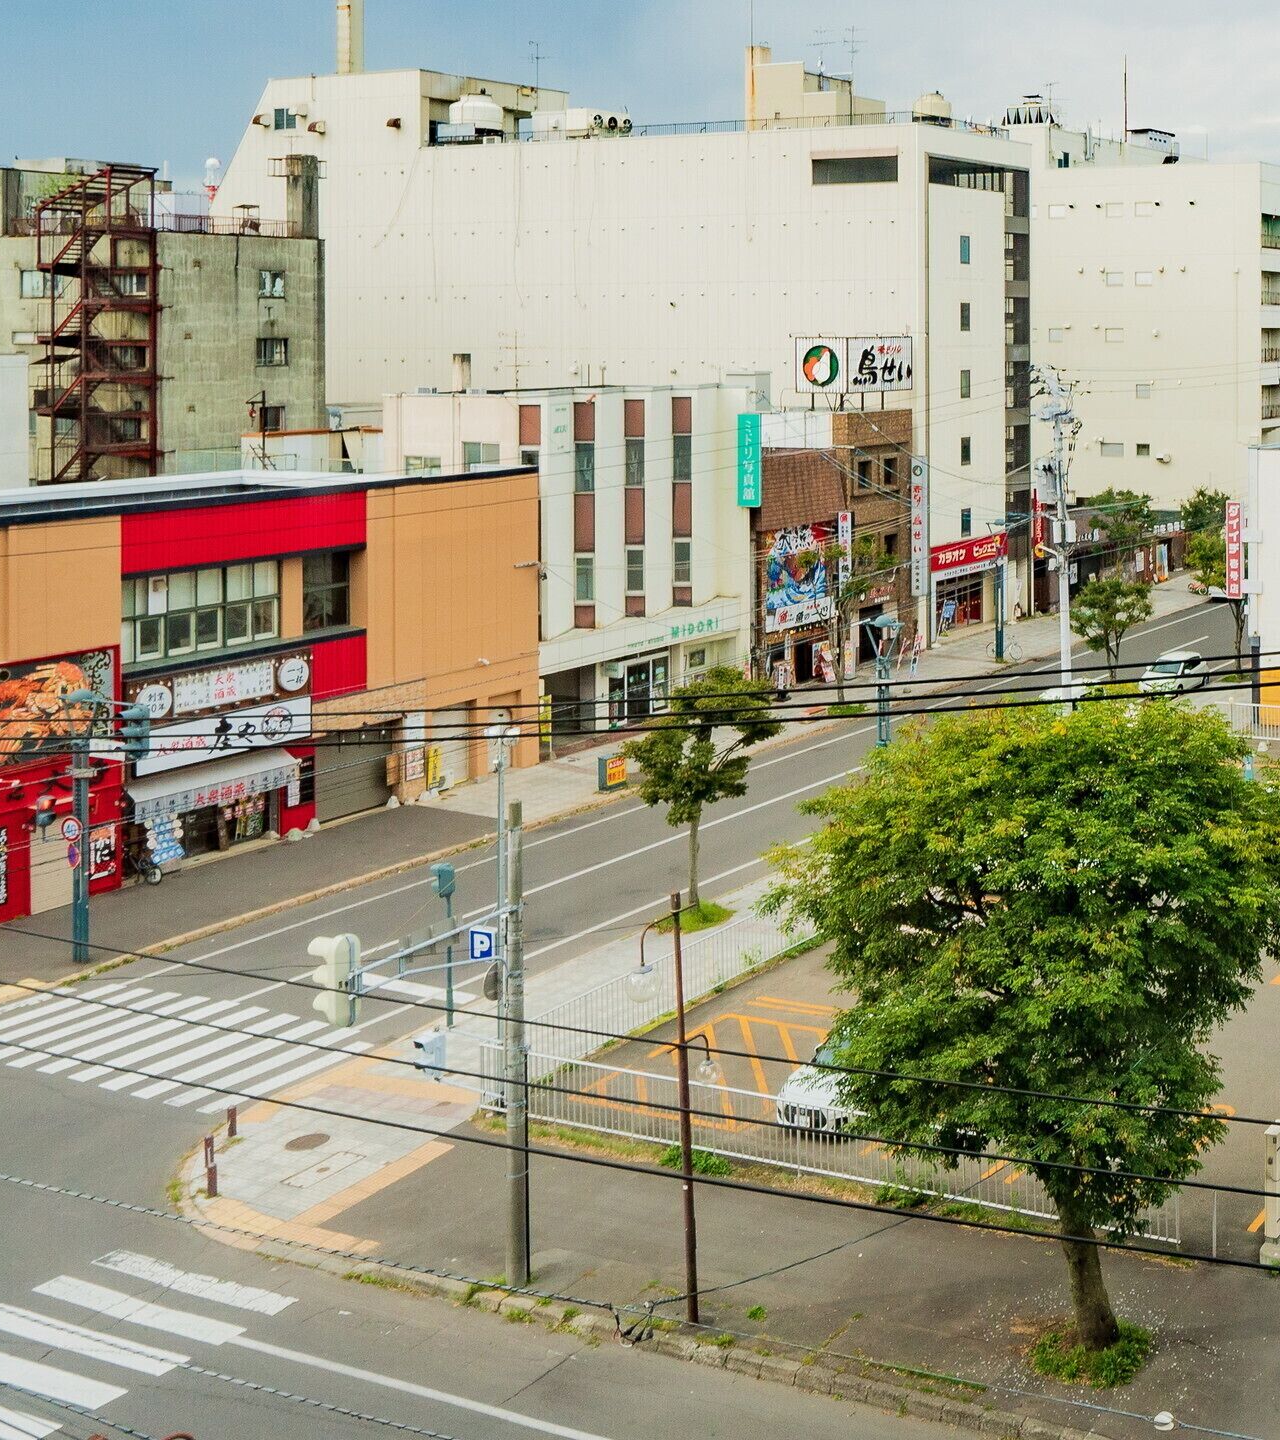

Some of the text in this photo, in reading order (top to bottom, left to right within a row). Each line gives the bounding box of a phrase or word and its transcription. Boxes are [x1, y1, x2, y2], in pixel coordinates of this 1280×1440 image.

[852, 345, 912, 386] 鳥せい
[938, 542, 999, 565] カラオケ ビッグエコ
[671, 617, 719, 639] MIDORI
[156, 734, 207, 757] 大衆酒蔵
[194, 781, 247, 807] 大衆酒蔵
[473, 934, 491, 958] P
